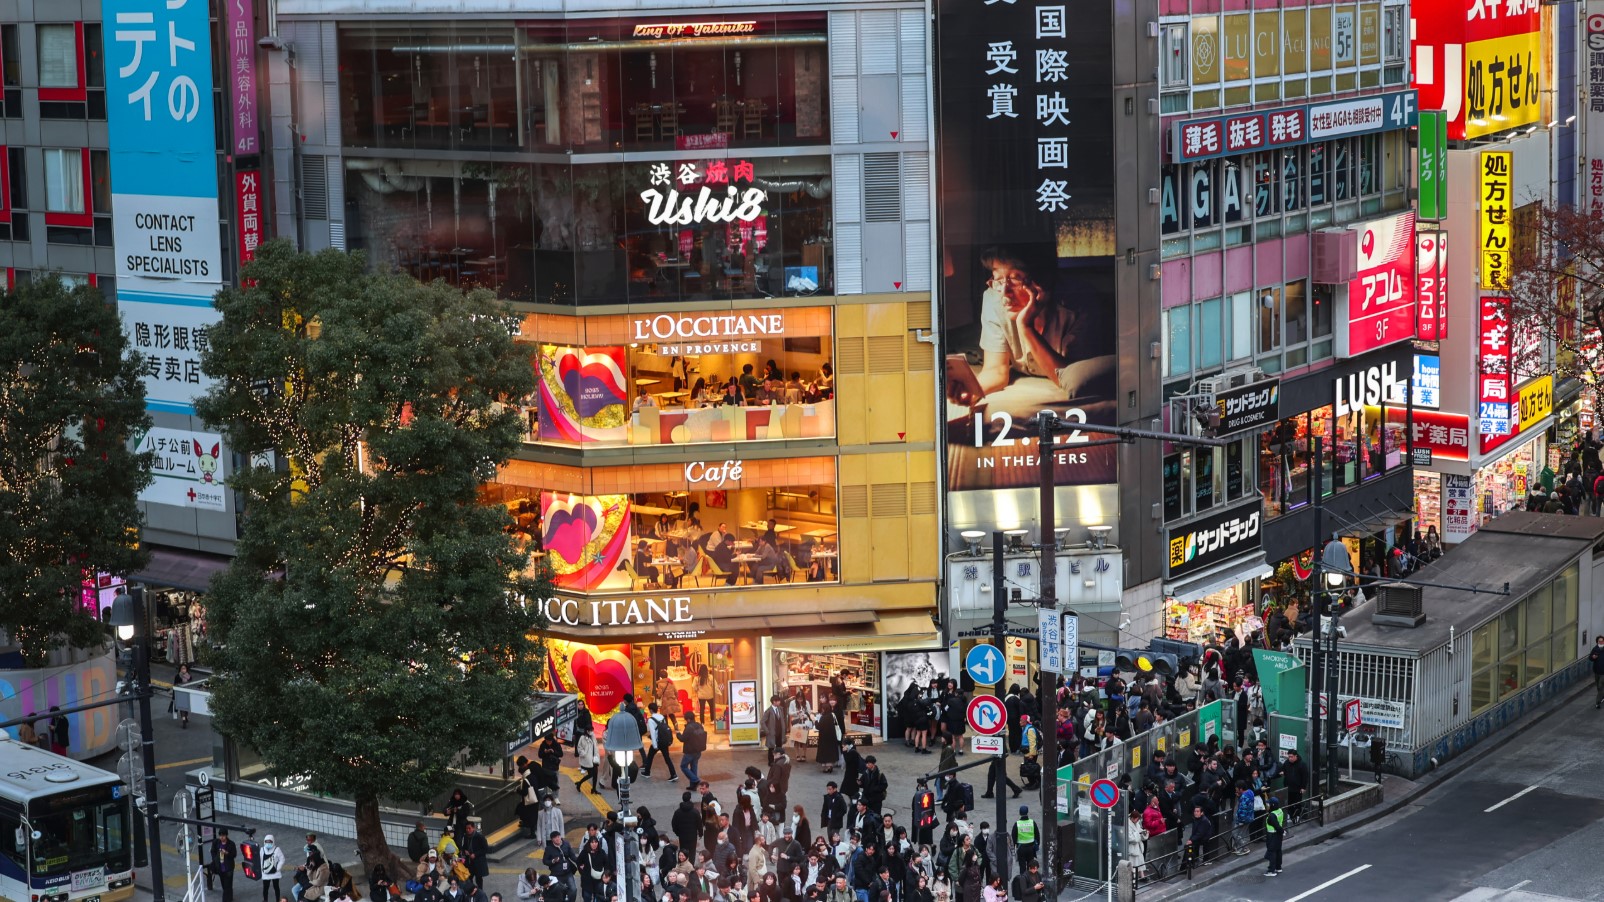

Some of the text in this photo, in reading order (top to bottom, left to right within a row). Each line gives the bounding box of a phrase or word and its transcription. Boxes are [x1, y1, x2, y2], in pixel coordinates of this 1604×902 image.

[1337, 31, 1352, 58] 5F
[166, 0, 199, 123] トの
[235, 20, 252, 129] 品川美容外科
[985, 40, 1019, 120] 受賞
[1467, 51, 1540, 121] 処方せん
[1035, 5, 1072, 213] 国際映画祭
[1311, 106, 1382, 132] 女性型AGAも相談受付中
[1390, 93, 1415, 126] 4F
[1186, 124, 1218, 155] 薄毛
[1230, 116, 1261, 148] 抜毛
[1271, 112, 1301, 144] 発毛
[238, 137, 255, 151] 4F
[649, 159, 755, 186] 渋谷焼肉
[1421, 148, 1433, 182] レイク
[242, 173, 259, 252] 外貨両替
[640, 185, 766, 226] Ushi8
[1161, 169, 1241, 225] AGA
[1484, 154, 1508, 248] 処方せん
[135, 213, 195, 232] CONTACT
[150, 236, 182, 253] LENS
[127, 256, 209, 277] SPECIALISTS
[1361, 268, 1403, 311] アコム
[1420, 277, 1434, 319] アコム
[634, 314, 785, 340] L'OCCITANE
[1375, 317, 1389, 341] 3F
[1422, 323, 1433, 331] 3F
[662, 342, 757, 355] EN PROVENCE
[1226, 388, 1270, 416] サンドラッグ
[1335, 360, 1397, 418] LUSH
[1520, 384, 1552, 422] 処方せん
[1228, 416, 1241, 428] DRUG
[1480, 403, 1494, 418] 24
[974, 408, 1089, 448] 12.2
[1480, 420, 1508, 433] 営業
[144, 453, 197, 475] 血ルーム
[685, 460, 743, 487] Café
[977, 452, 1088, 468] IN THEERS
[1197, 511, 1260, 556] サンドラッグ
[1047, 614, 1060, 668] 渋谷駅前
[1262, 654, 1289, 664] SMOKING
[1274, 662, 1289, 671] AREA
